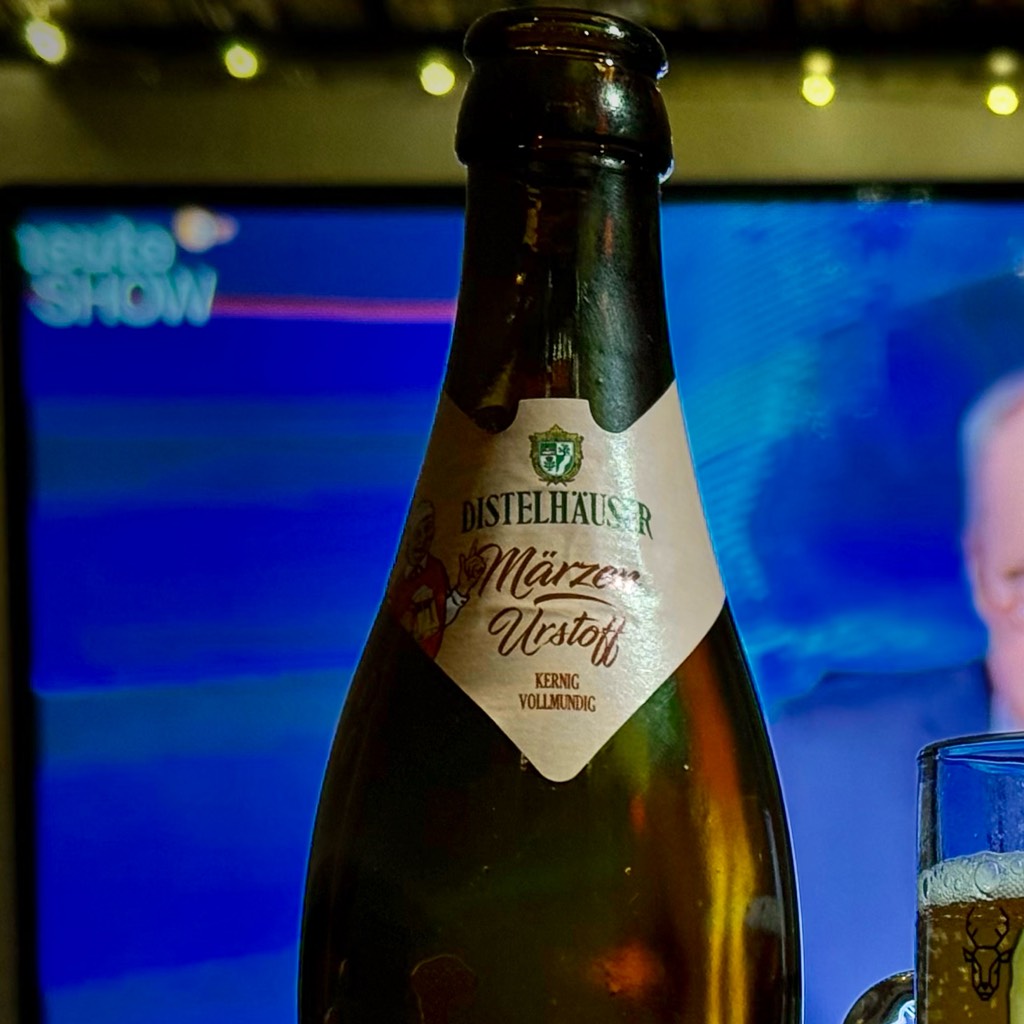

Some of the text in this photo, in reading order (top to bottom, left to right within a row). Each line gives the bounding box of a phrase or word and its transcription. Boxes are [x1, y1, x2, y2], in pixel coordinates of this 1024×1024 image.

[29, 264, 217, 327] SHOW
[461, 490, 654, 540] DISTELHÄUSER
[476, 543, 641, 599] Märzen
[488, 606, 627, 668] Urstoff
[518, 693, 596, 713] VOLLMUNDIG
[535, 672, 580, 690] KERNIG
